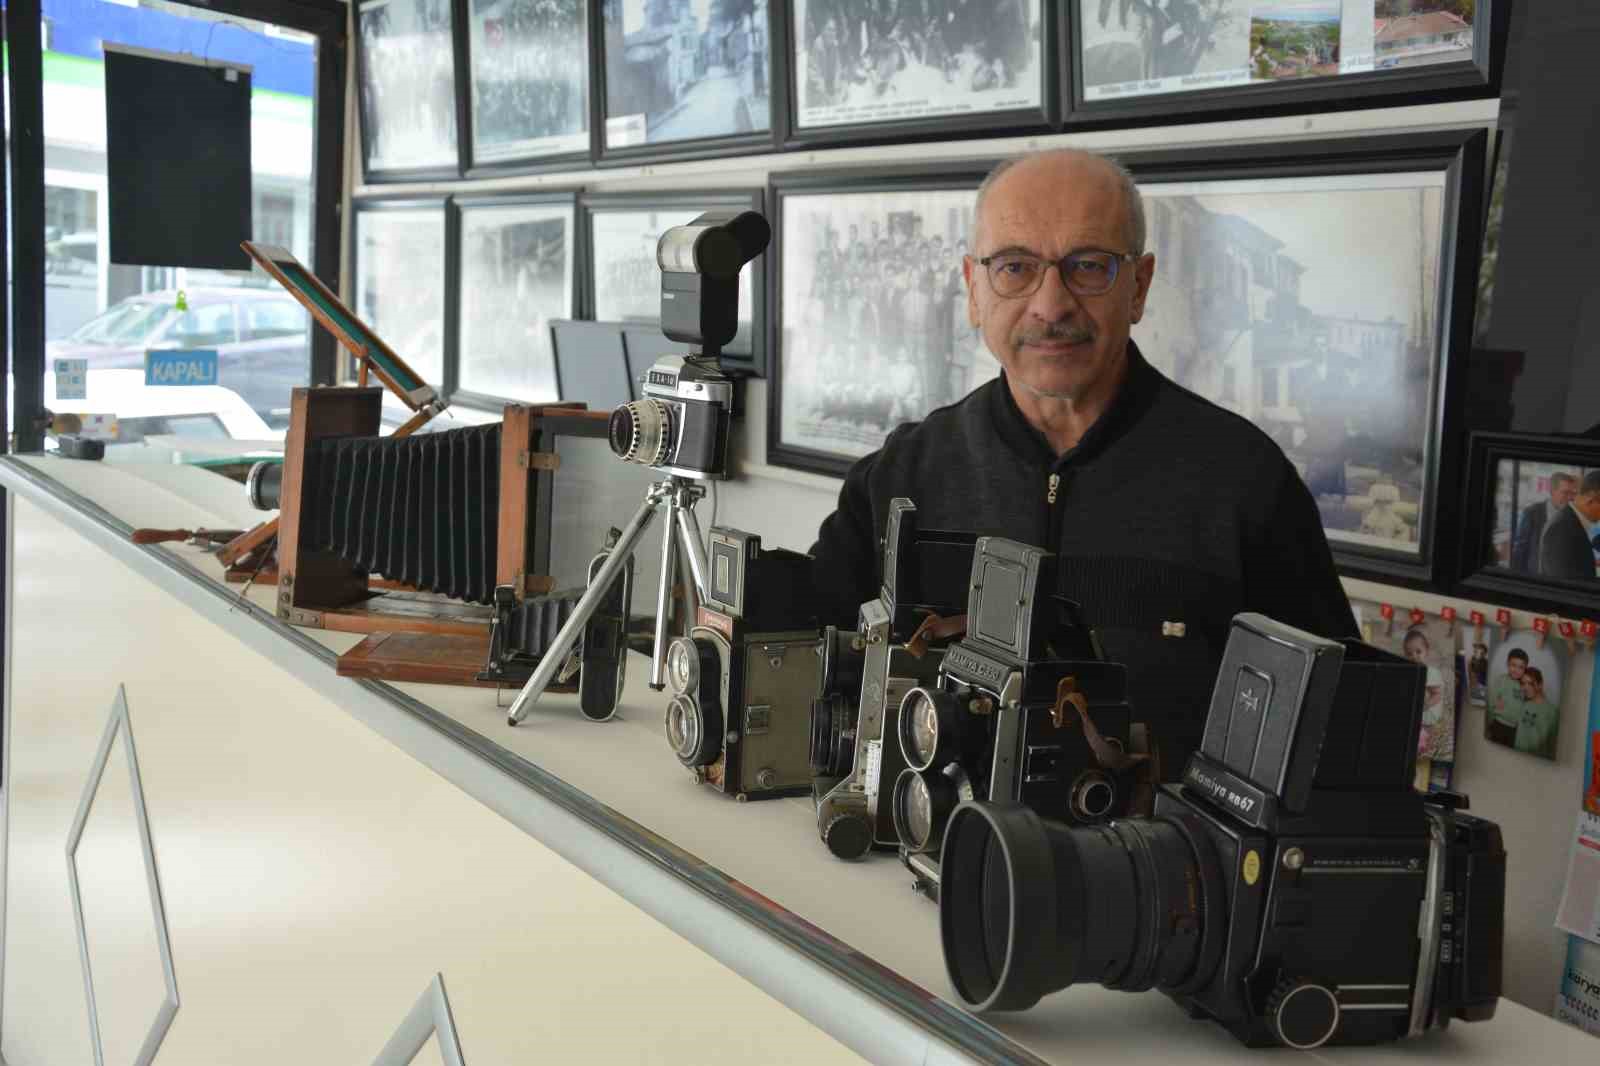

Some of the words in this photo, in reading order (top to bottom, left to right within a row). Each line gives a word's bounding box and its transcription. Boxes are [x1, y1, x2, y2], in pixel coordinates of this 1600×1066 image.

[152, 359, 214, 383] KAPALI
[1190, 767, 1227, 798] Mamiya
[1228, 791, 1255, 812] RB67
